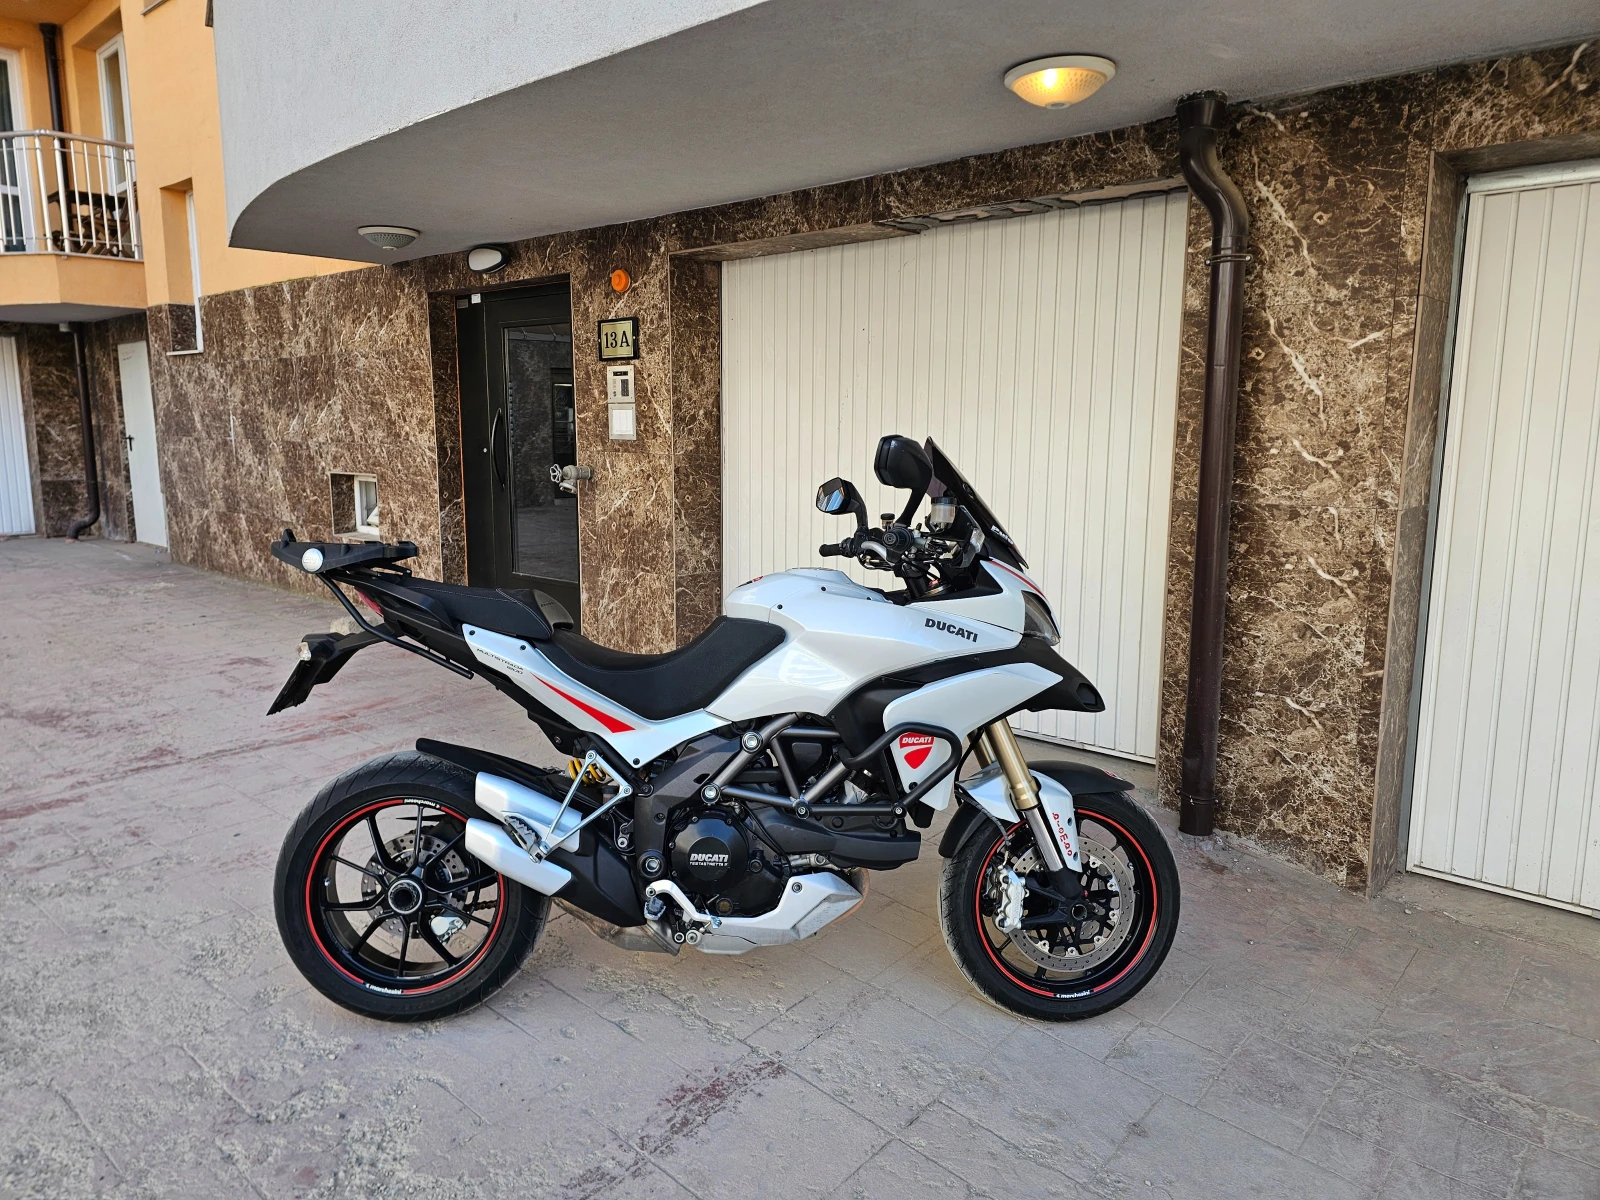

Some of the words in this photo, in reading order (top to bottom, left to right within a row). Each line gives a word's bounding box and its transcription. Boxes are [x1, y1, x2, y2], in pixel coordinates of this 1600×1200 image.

[924, 617, 979, 643] DUCATI
[476, 648, 524, 671] MULTISTRADA
[901, 736, 932, 744] DUCATI
[689, 853, 729, 863] DUCATI
